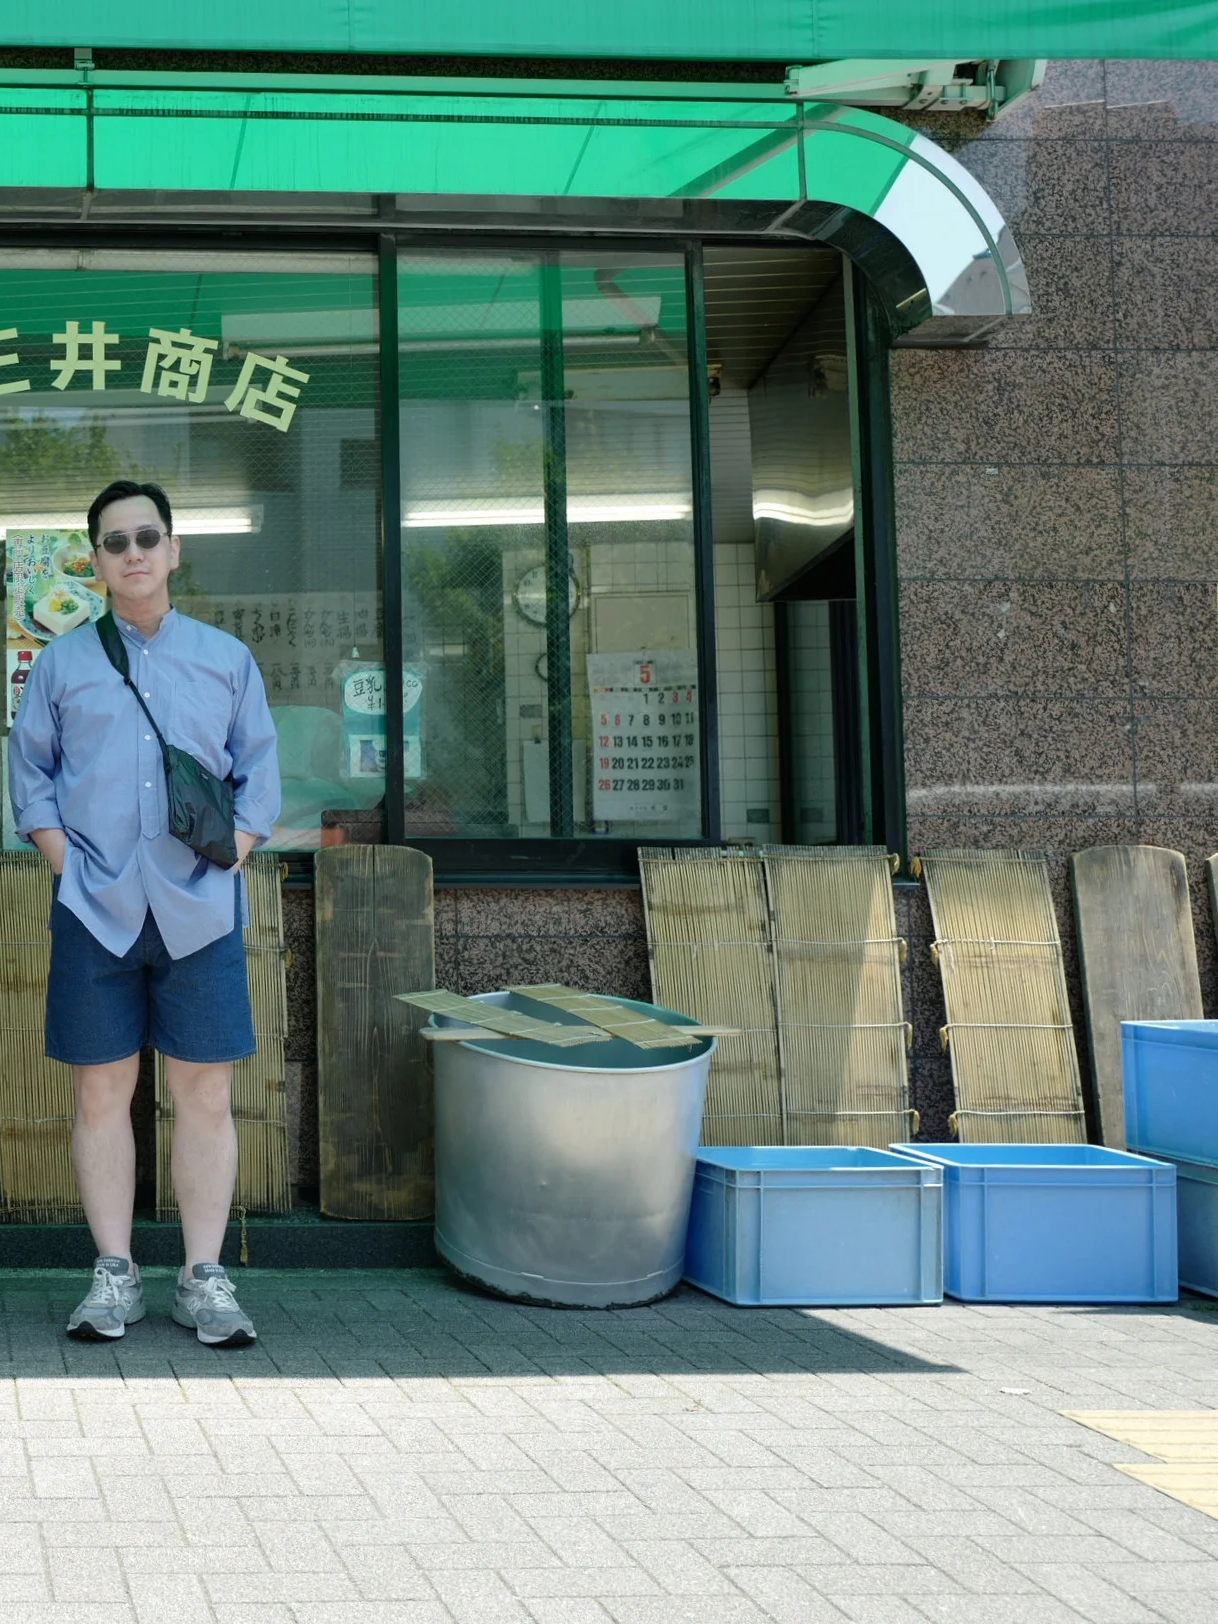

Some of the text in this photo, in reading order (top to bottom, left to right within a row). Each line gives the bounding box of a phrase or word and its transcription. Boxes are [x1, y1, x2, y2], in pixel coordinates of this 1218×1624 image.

[639, 664, 651, 684] 5
[352, 675, 382, 698] 豆乳
[643, 693, 649, 704] 1
[658, 693, 665, 704] 2
[601, 714, 607, 726] 5
[628, 714, 635, 726] 7
[643, 714, 650, 726] 8
[658, 714, 665, 726] 9
[671, 713, 681, 725] 10
[599, 735, 609, 748] 12
[613, 735, 623, 748] 13
[626, 735, 638, 748] 14
[641, 735, 653, 748] 15
[657, 735, 669, 748] 16
[672, 735, 681, 747] 17
[599, 757, 610, 770] 19
[612, 757, 625, 770] 20
[627, 757, 639, 770] 21
[641, 757, 654, 770] 22
[656, 757, 670, 769] 23
[598, 778, 684, 791] 26 27 28 29 30 31
